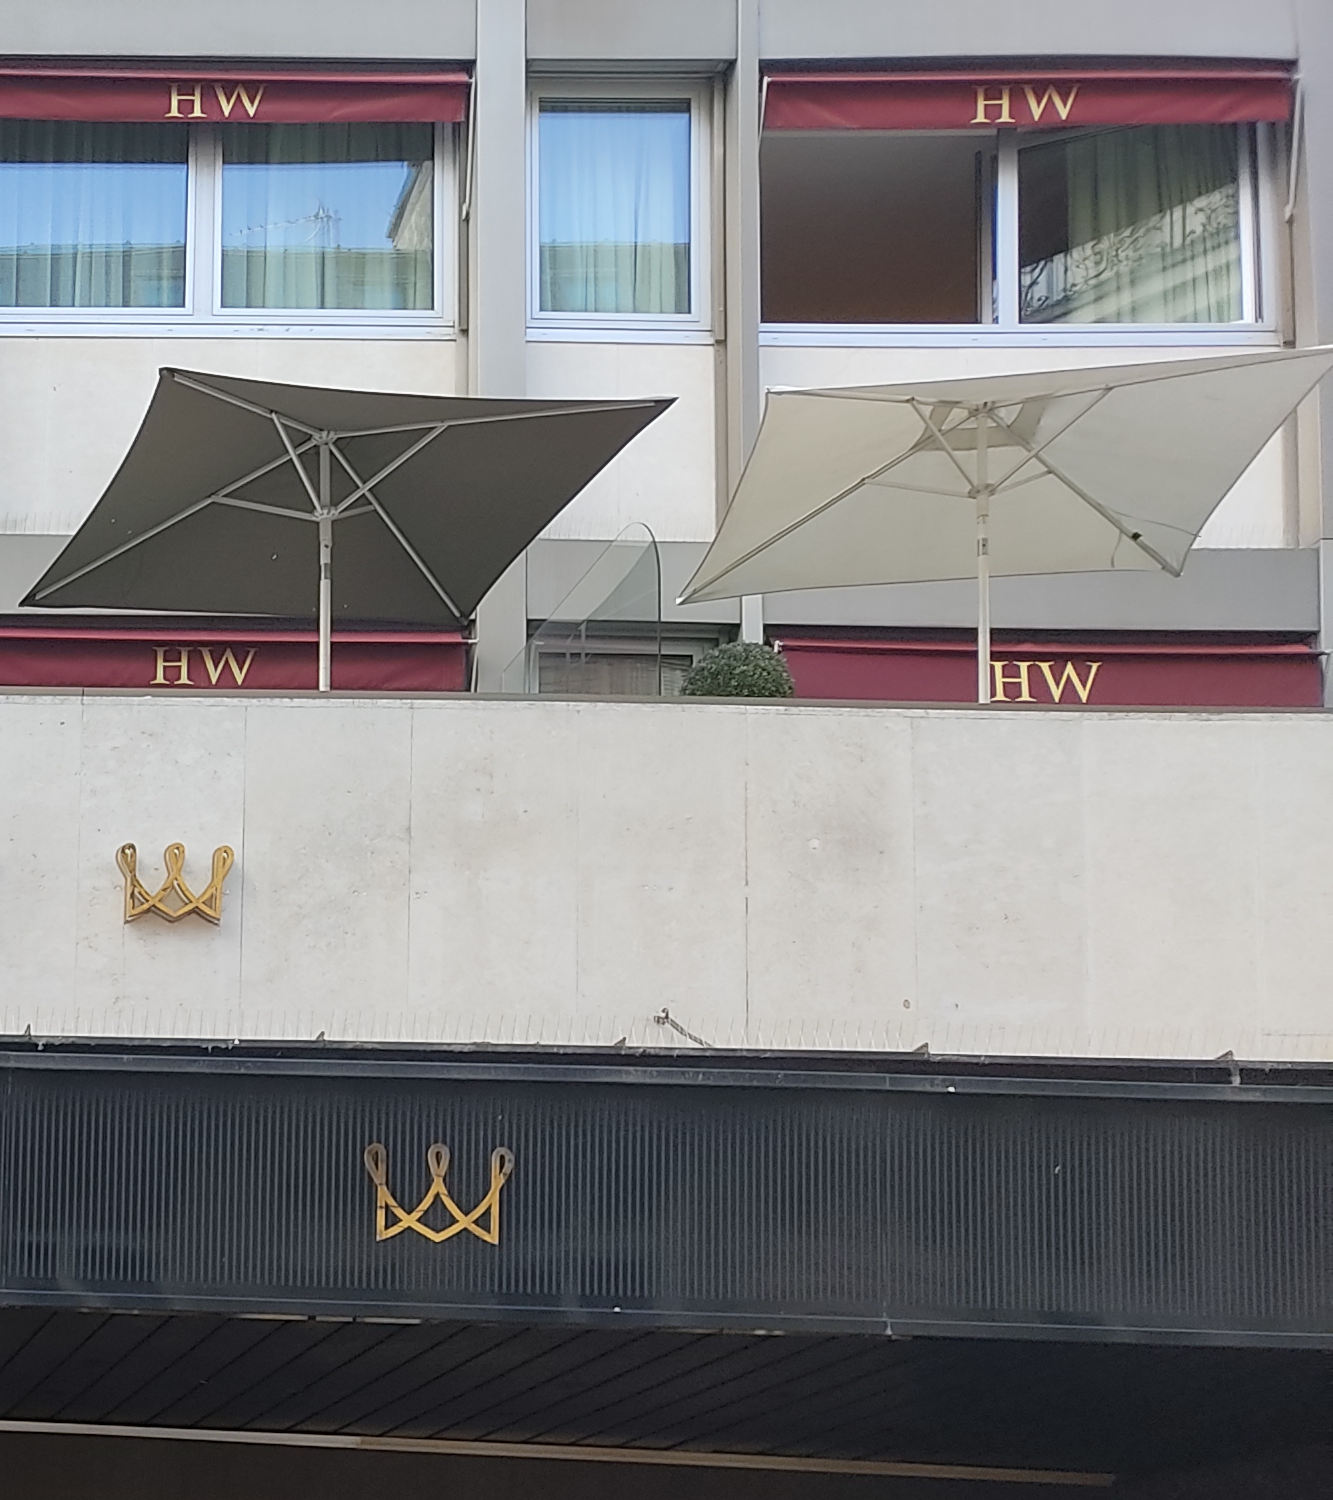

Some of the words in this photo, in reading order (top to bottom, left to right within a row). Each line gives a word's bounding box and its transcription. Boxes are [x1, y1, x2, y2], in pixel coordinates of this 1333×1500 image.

[164, 83, 266, 118] HW
[969, 83, 1080, 124] HW
[149, 647, 256, 687] HW
[988, 660, 1102, 703] HW
